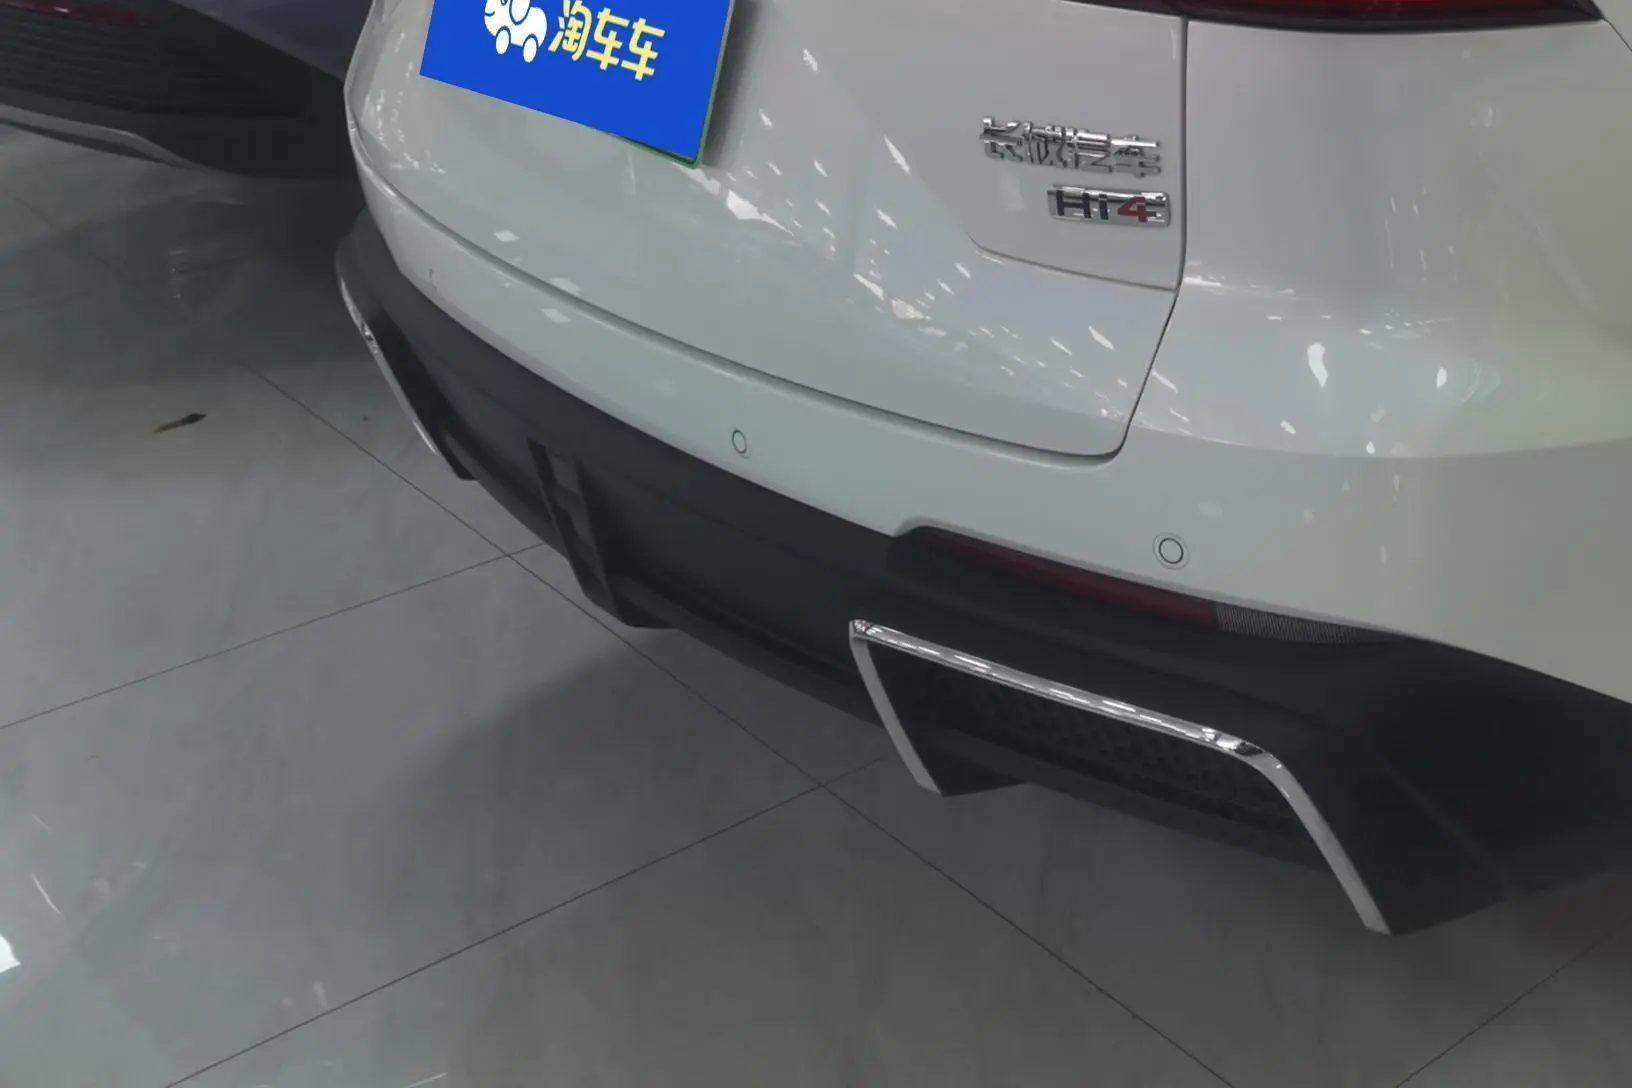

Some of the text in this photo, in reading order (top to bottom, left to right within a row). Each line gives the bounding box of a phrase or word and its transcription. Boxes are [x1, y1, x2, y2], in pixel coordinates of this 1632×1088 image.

[980, 115, 1162, 178] 长城汽车
[1055, 188, 1157, 224] Hi4
